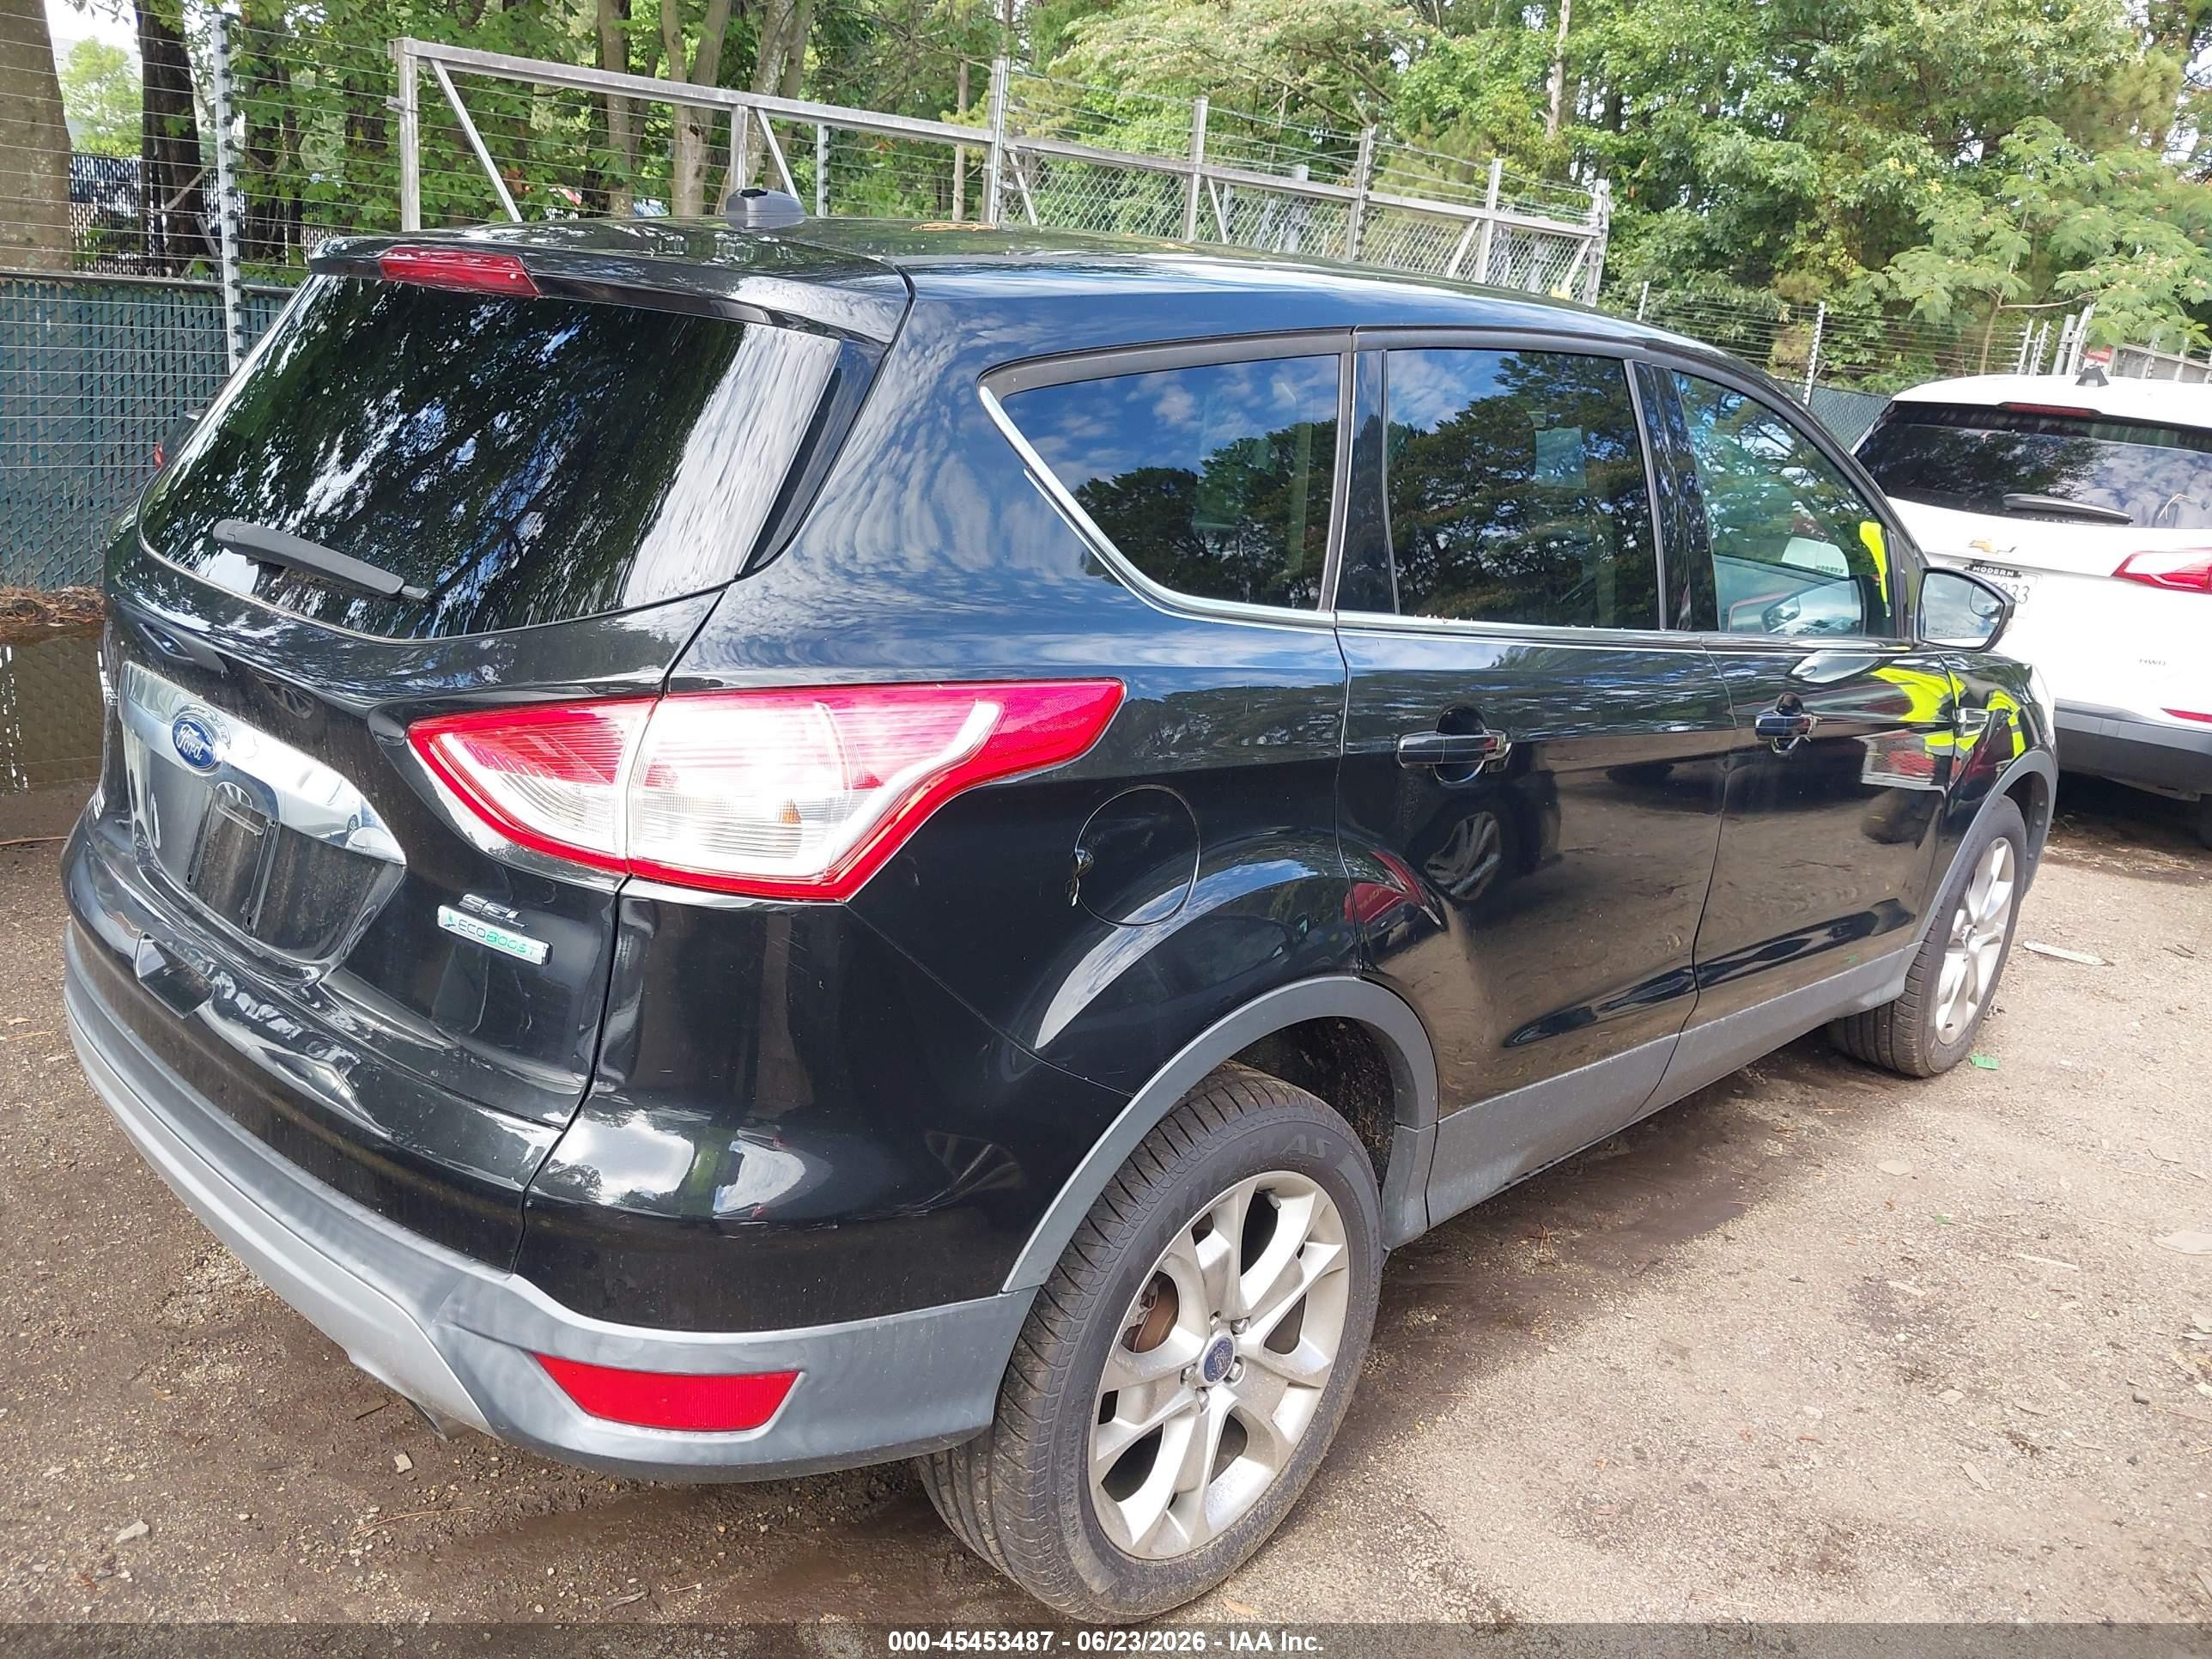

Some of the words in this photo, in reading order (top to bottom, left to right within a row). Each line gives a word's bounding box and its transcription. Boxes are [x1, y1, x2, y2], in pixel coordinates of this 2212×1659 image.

[1972, 566, 2014, 577] MODERN
[176, 723, 204, 761] Ford
[458, 893, 527, 928] SEL
